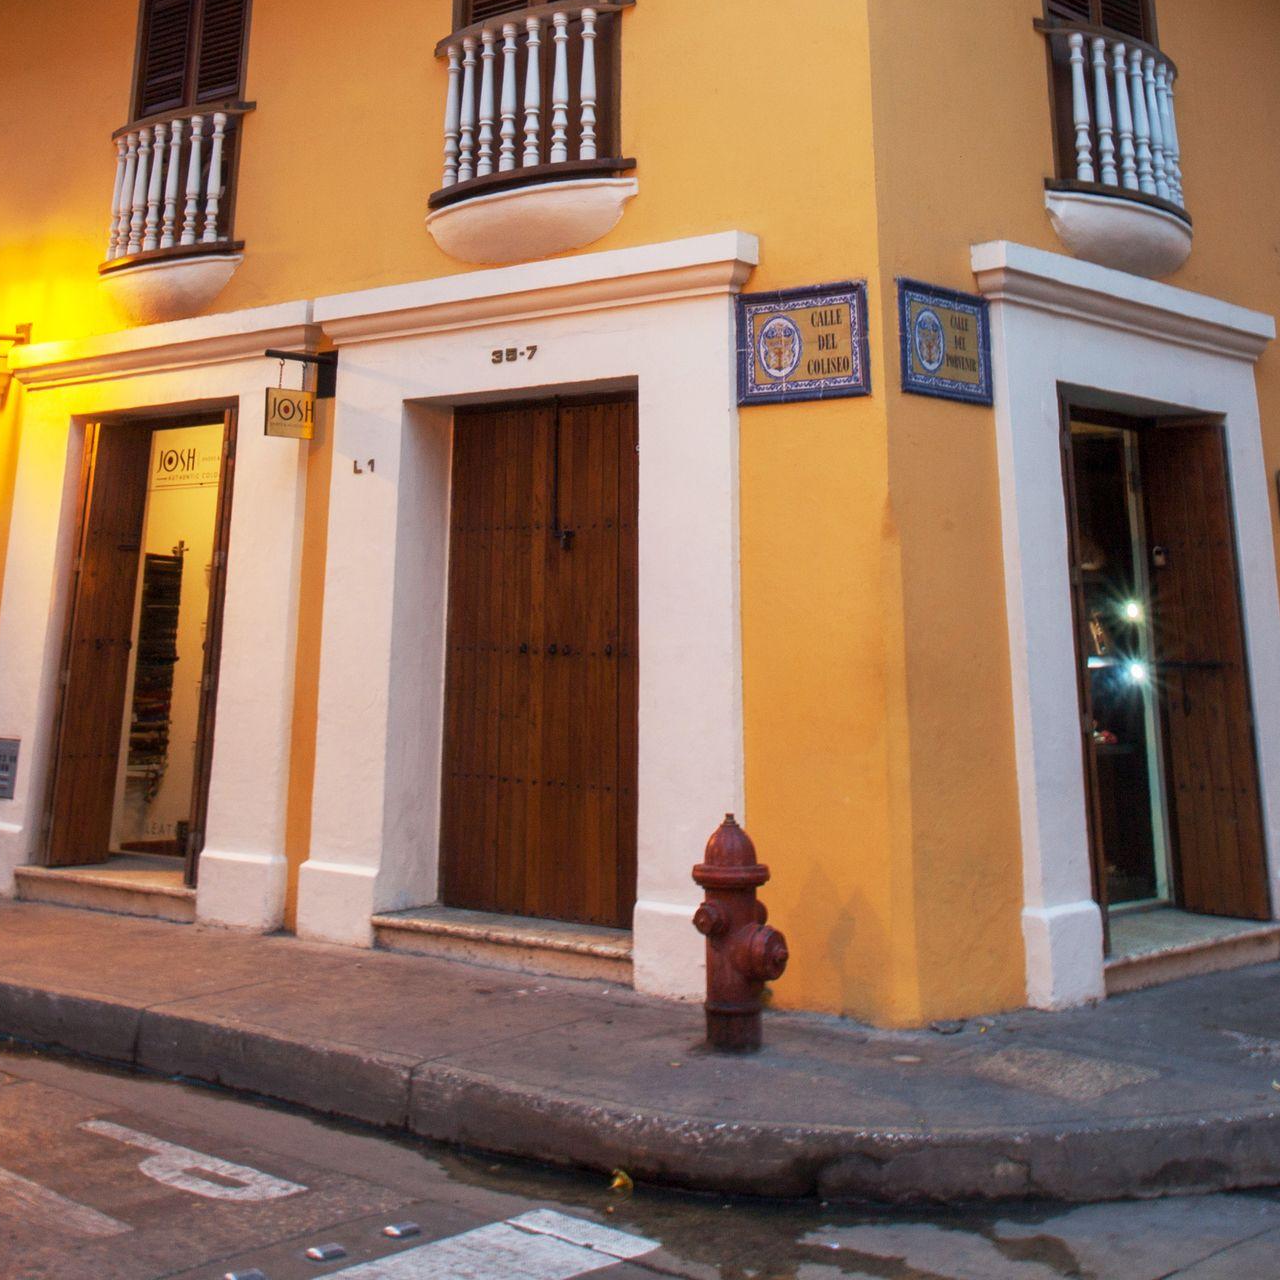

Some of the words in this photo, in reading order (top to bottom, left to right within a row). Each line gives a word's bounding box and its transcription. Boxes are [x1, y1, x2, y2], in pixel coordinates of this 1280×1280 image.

[811, 308, 842, 328] CALLE
[950, 314, 968, 331] CALLE
[818, 333, 837, 351] DEL
[954, 335, 966, 351] DEL
[807, 356, 850, 375] COLISEO
[945, 352, 976, 372] PORVENIR
[270, 397, 314, 423] JOSH
[156, 448, 196, 473] JOSH
